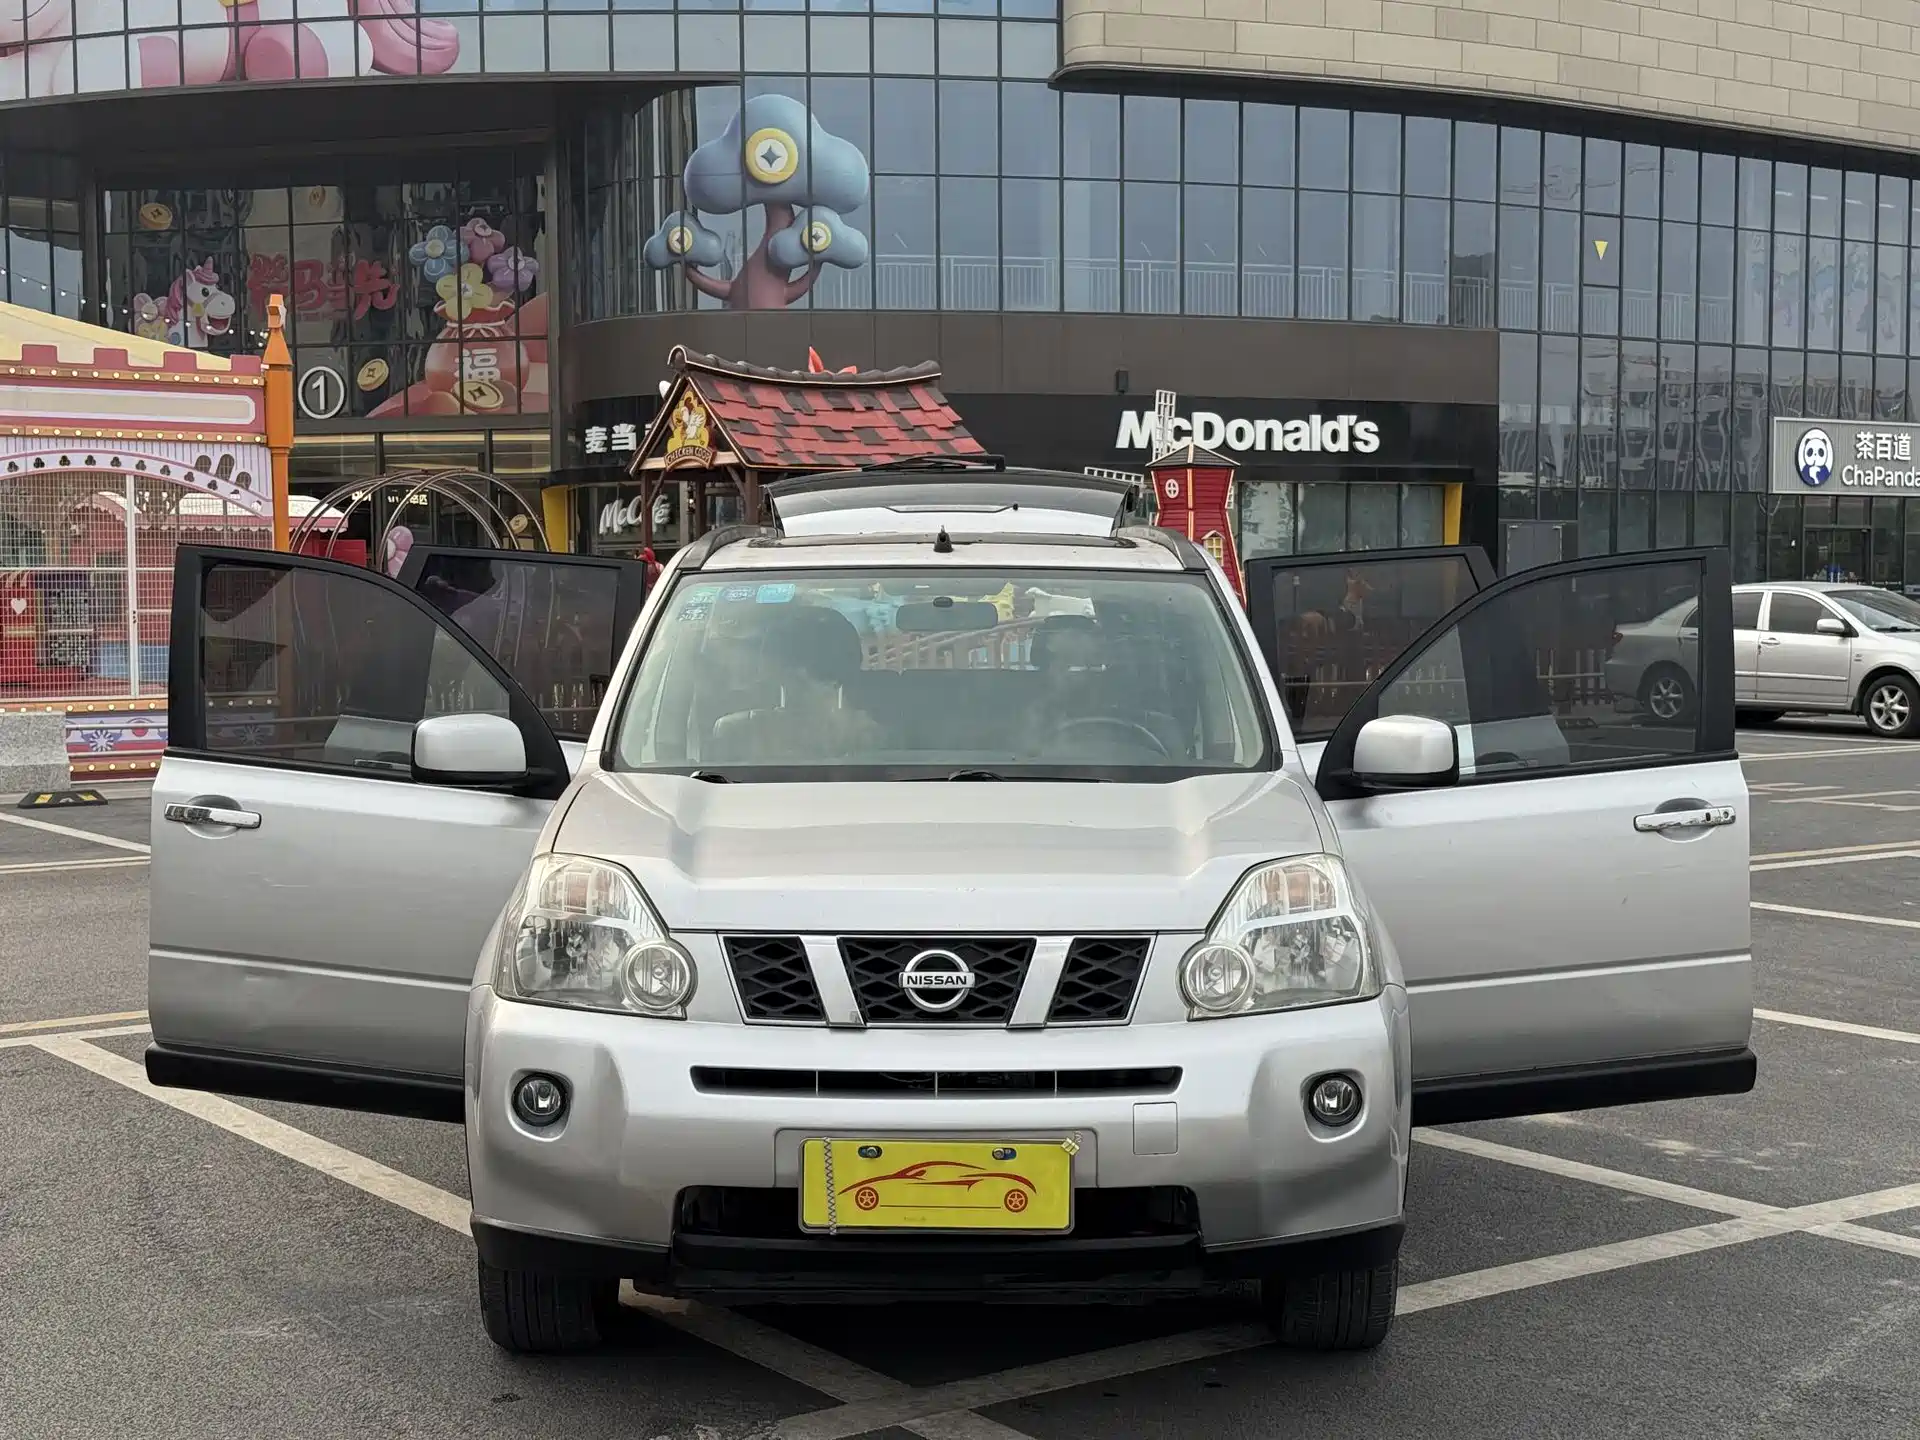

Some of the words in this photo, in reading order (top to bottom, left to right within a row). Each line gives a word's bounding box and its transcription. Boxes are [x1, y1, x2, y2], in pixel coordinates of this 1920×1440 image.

[585, 423, 653, 454] 麦当
[1115, 410, 1380, 453] McDonald's
[1856, 431, 1911, 461] 茶百道
[667, 446, 694, 462] CHICKEN
[1842, 464, 1920, 487] ChaPanda
[599, 494, 671, 534] McCfé
[906, 975, 967, 985] NISSAN
